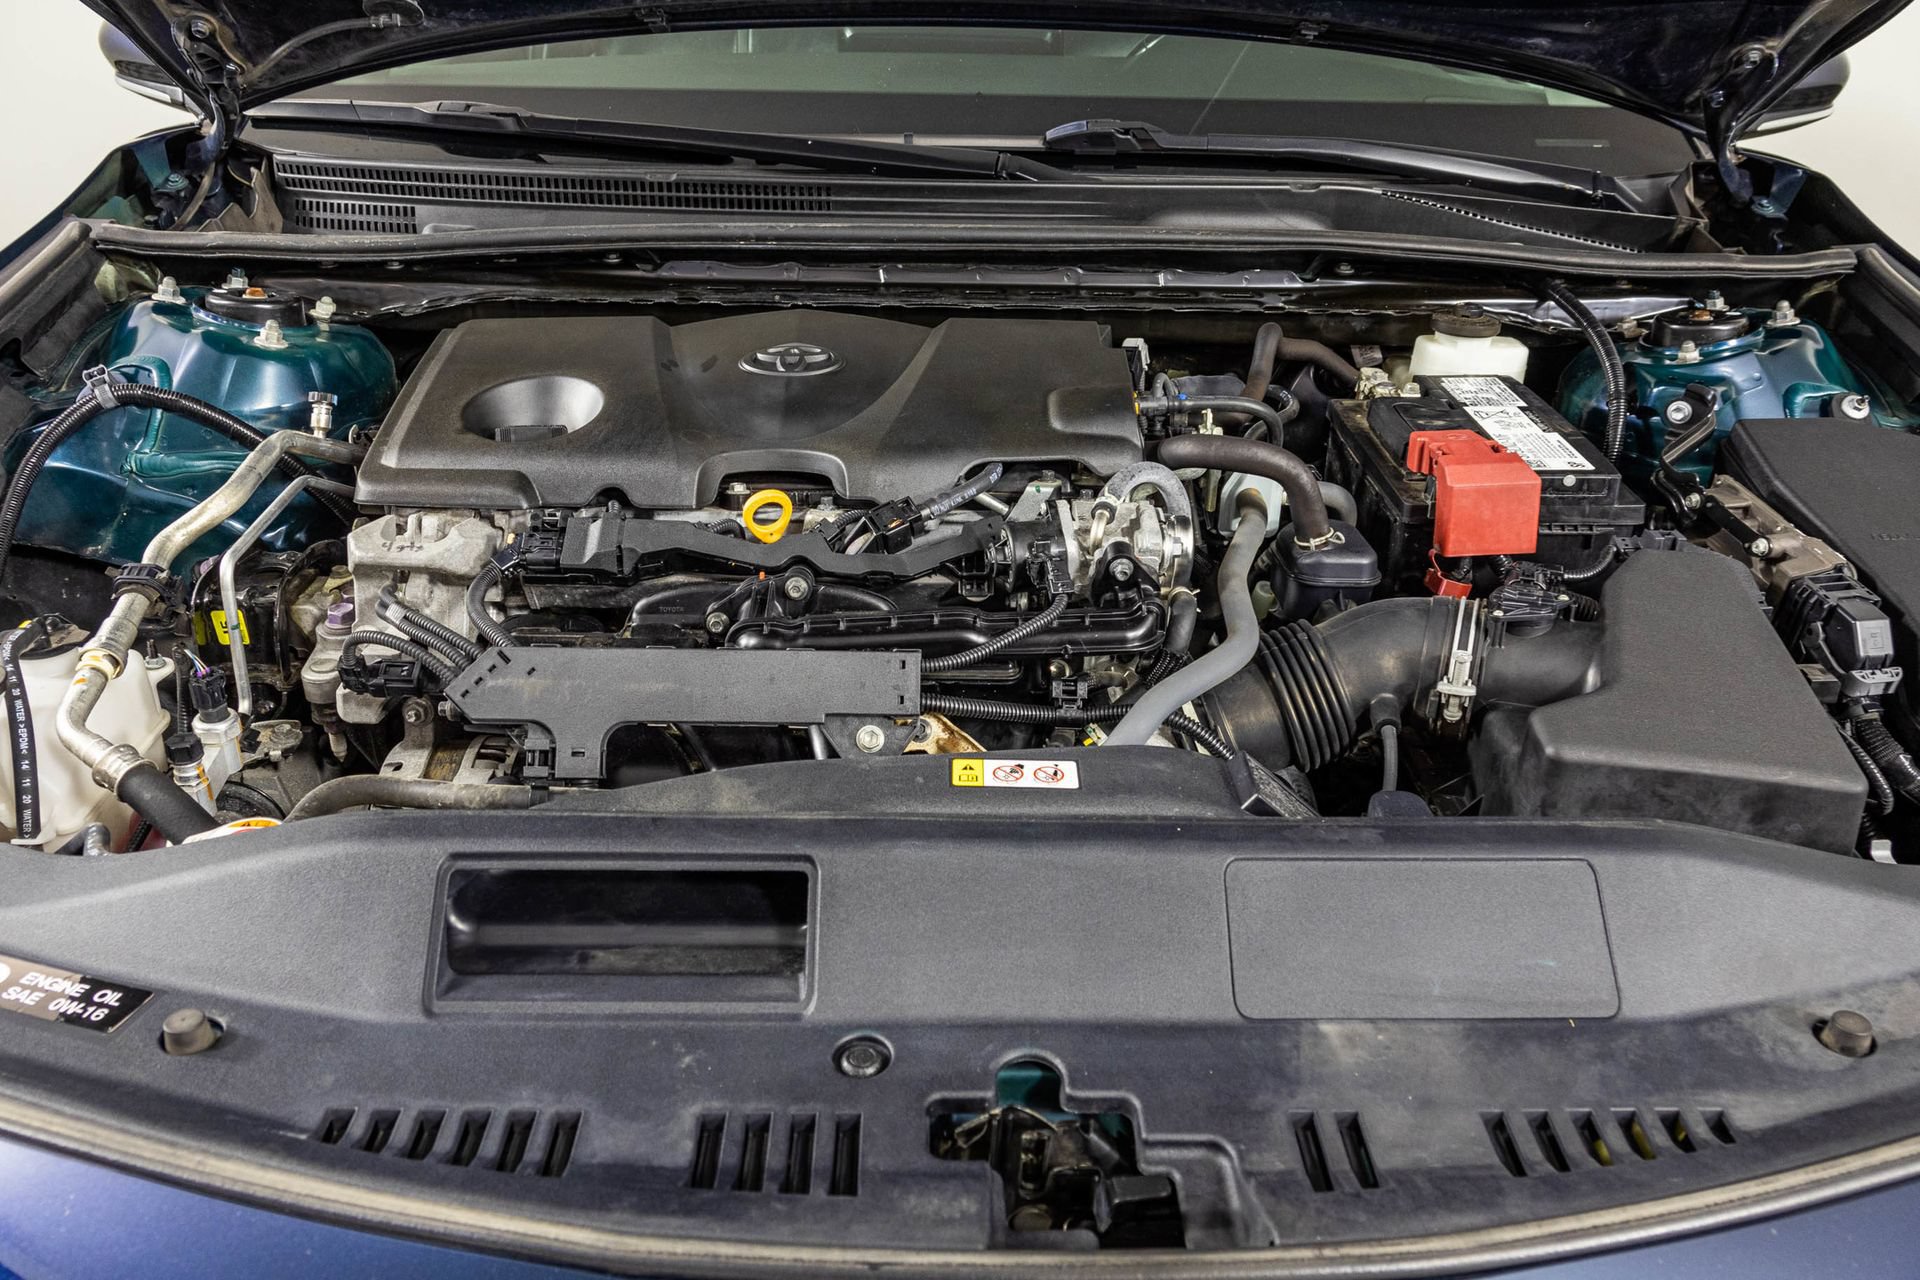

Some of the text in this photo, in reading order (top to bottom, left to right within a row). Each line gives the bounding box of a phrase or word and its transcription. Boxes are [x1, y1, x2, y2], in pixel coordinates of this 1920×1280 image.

[14, 698, 26, 722] WATER
[21, 760, 30, 769] 14
[22, 794, 32, 804] 20
[22, 808, 32, 833] WATER
[18, 971, 123, 1007] ENGINE OIL
[1, 986, 110, 1021] SAE 0W-16
